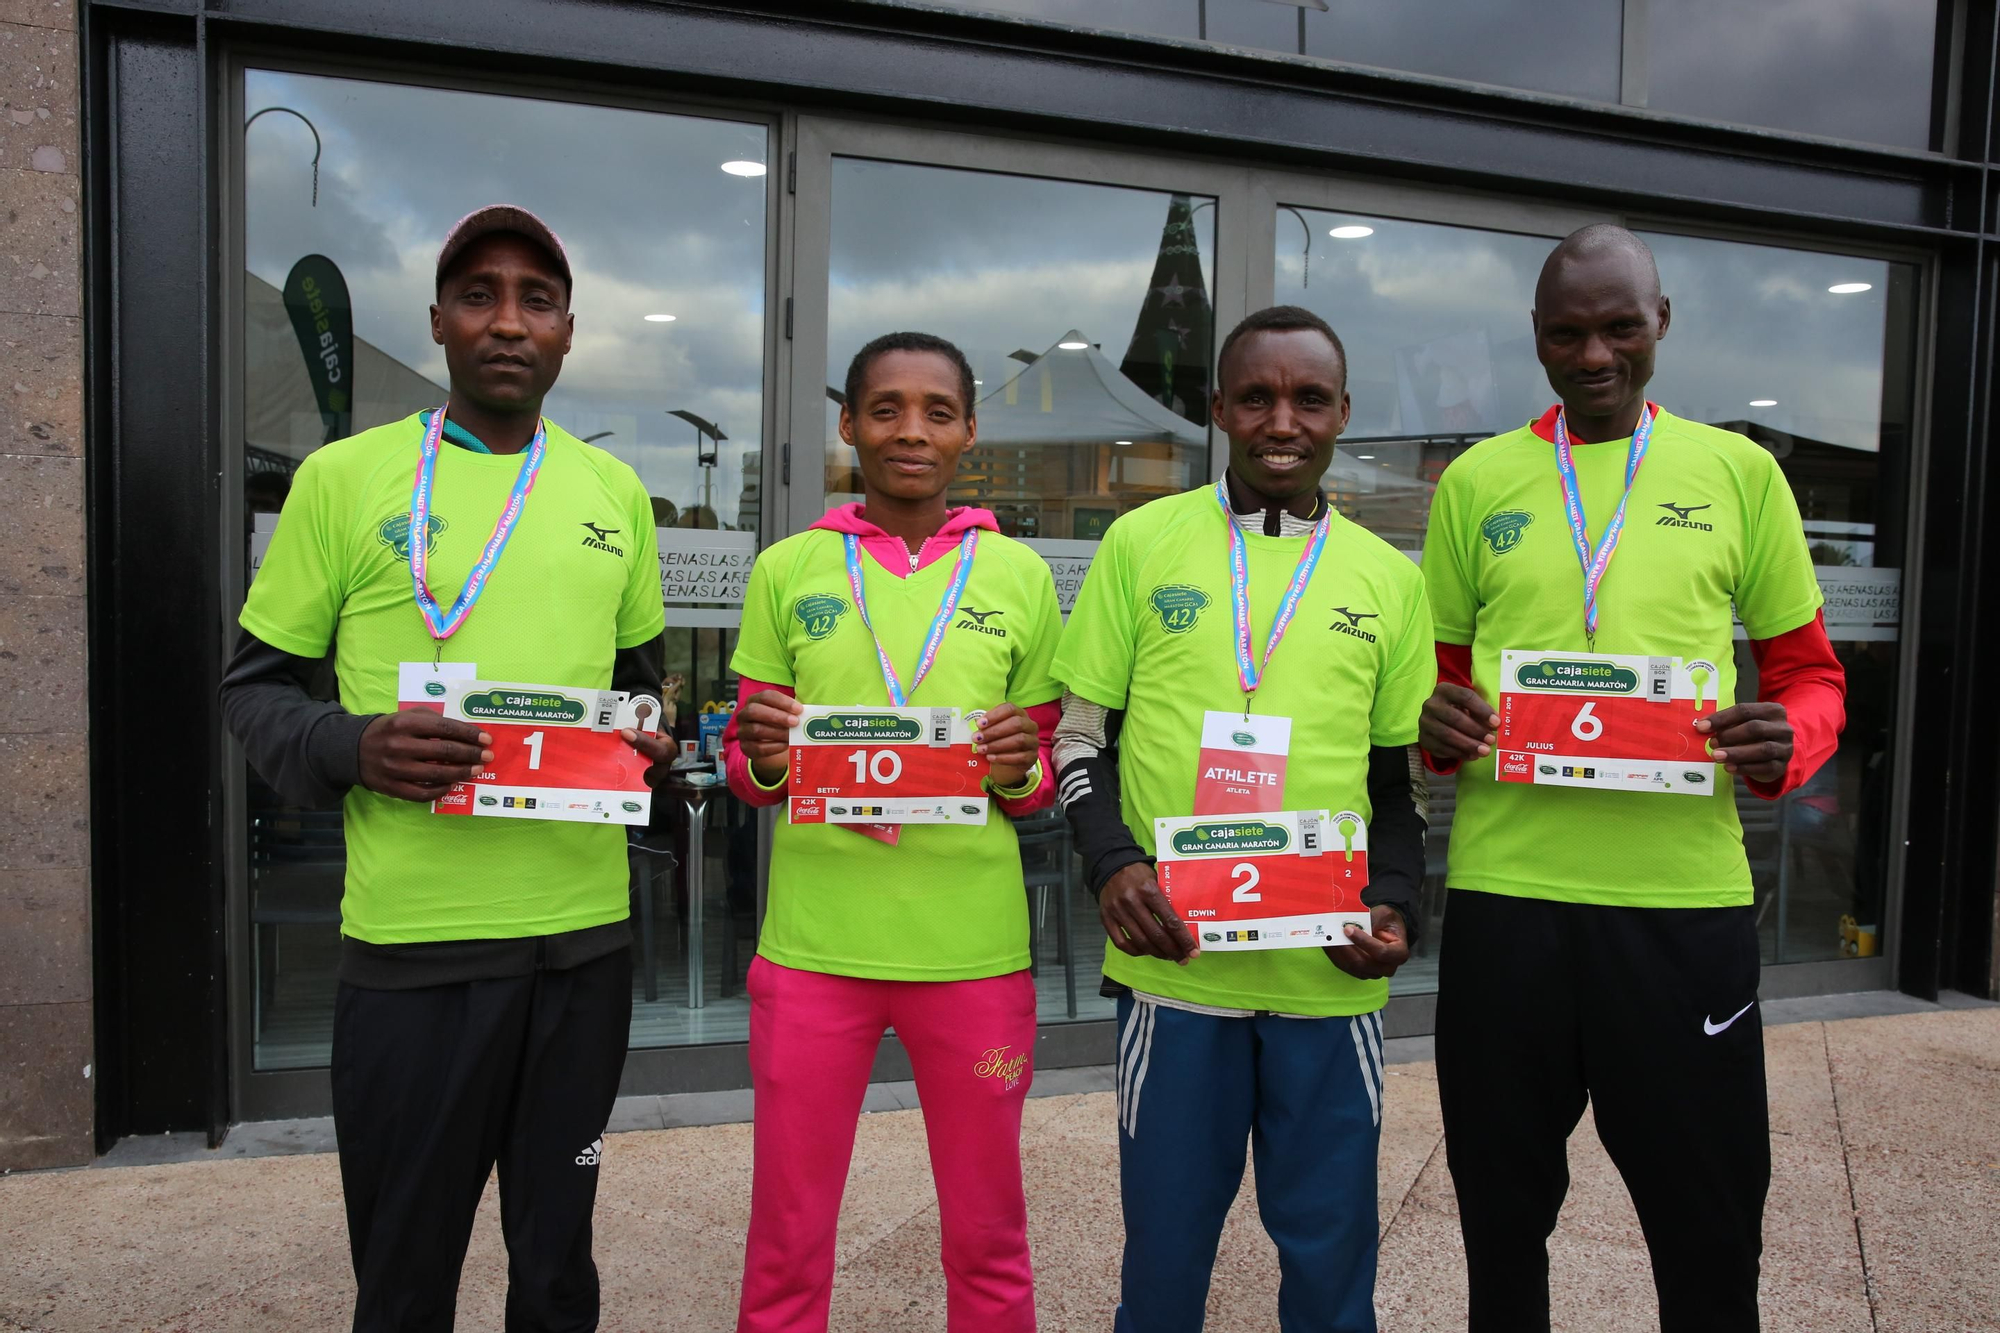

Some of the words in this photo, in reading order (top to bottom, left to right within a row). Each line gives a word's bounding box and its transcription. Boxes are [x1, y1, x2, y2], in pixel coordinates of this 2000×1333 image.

[1655, 517, 1712, 532] MIZUNO
[1496, 530, 1515, 547] 42
[455, 580, 480, 616] CAJASIETE
[475, 558, 491, 580] GRAN
[487, 527, 507, 558] CANARIA
[504, 493, 522, 527] MARATÓN
[582, 537, 623, 557] MIZUNO
[1598, 534, 1616, 563] CANARIA
[710, 554, 739, 567] LAS
[688, 571, 716, 583] LAS
[711, 586, 740, 598] LAS
[1289, 584, 1301, 603] GRAN
[1235, 537, 1243, 572] CAJASIETE
[1240, 630, 1249, 670] MARATÓN
[811, 615, 830, 633] 42
[1168, 609, 1190, 626] 42
[956, 619, 1006, 637] MIZUNO
[1329, 621, 1376, 644] MIZUNO
[1557, 665, 1612, 677] cajasiete
[1549, 679, 1585, 687] CANARIA
[1587, 680, 1627, 689] MARATÓN
[1653, 679, 1666, 694] E
[506, 696, 562, 709] cajasiete
[472, 707, 496, 715] GRAN
[498, 708, 533, 717] CANARIA
[535, 711, 574, 719] MARATÓN
[598, 711, 611, 725] E
[845, 718, 897, 728] cajasiete
[1571, 702, 1603, 741] 6
[874, 730, 911, 738] MARATÓN
[935, 728, 947, 741] E
[523, 731, 544, 770] 1
[1525, 742, 1553, 750] JULIUS
[848, 750, 902, 784] 10
[474, 772, 496, 780] LIUS
[1204, 767, 1277, 785] ATHLETE
[1211, 827, 1263, 839] cajasiete
[1182, 843, 1205, 851] GRAN
[1205, 842, 1239, 850] CANARIA
[1241, 839, 1280, 848] MARATÓN
[1304, 833, 1317, 849] E
[1231, 862, 1262, 903] 2
[1188, 909, 1215, 917] EDWIN
